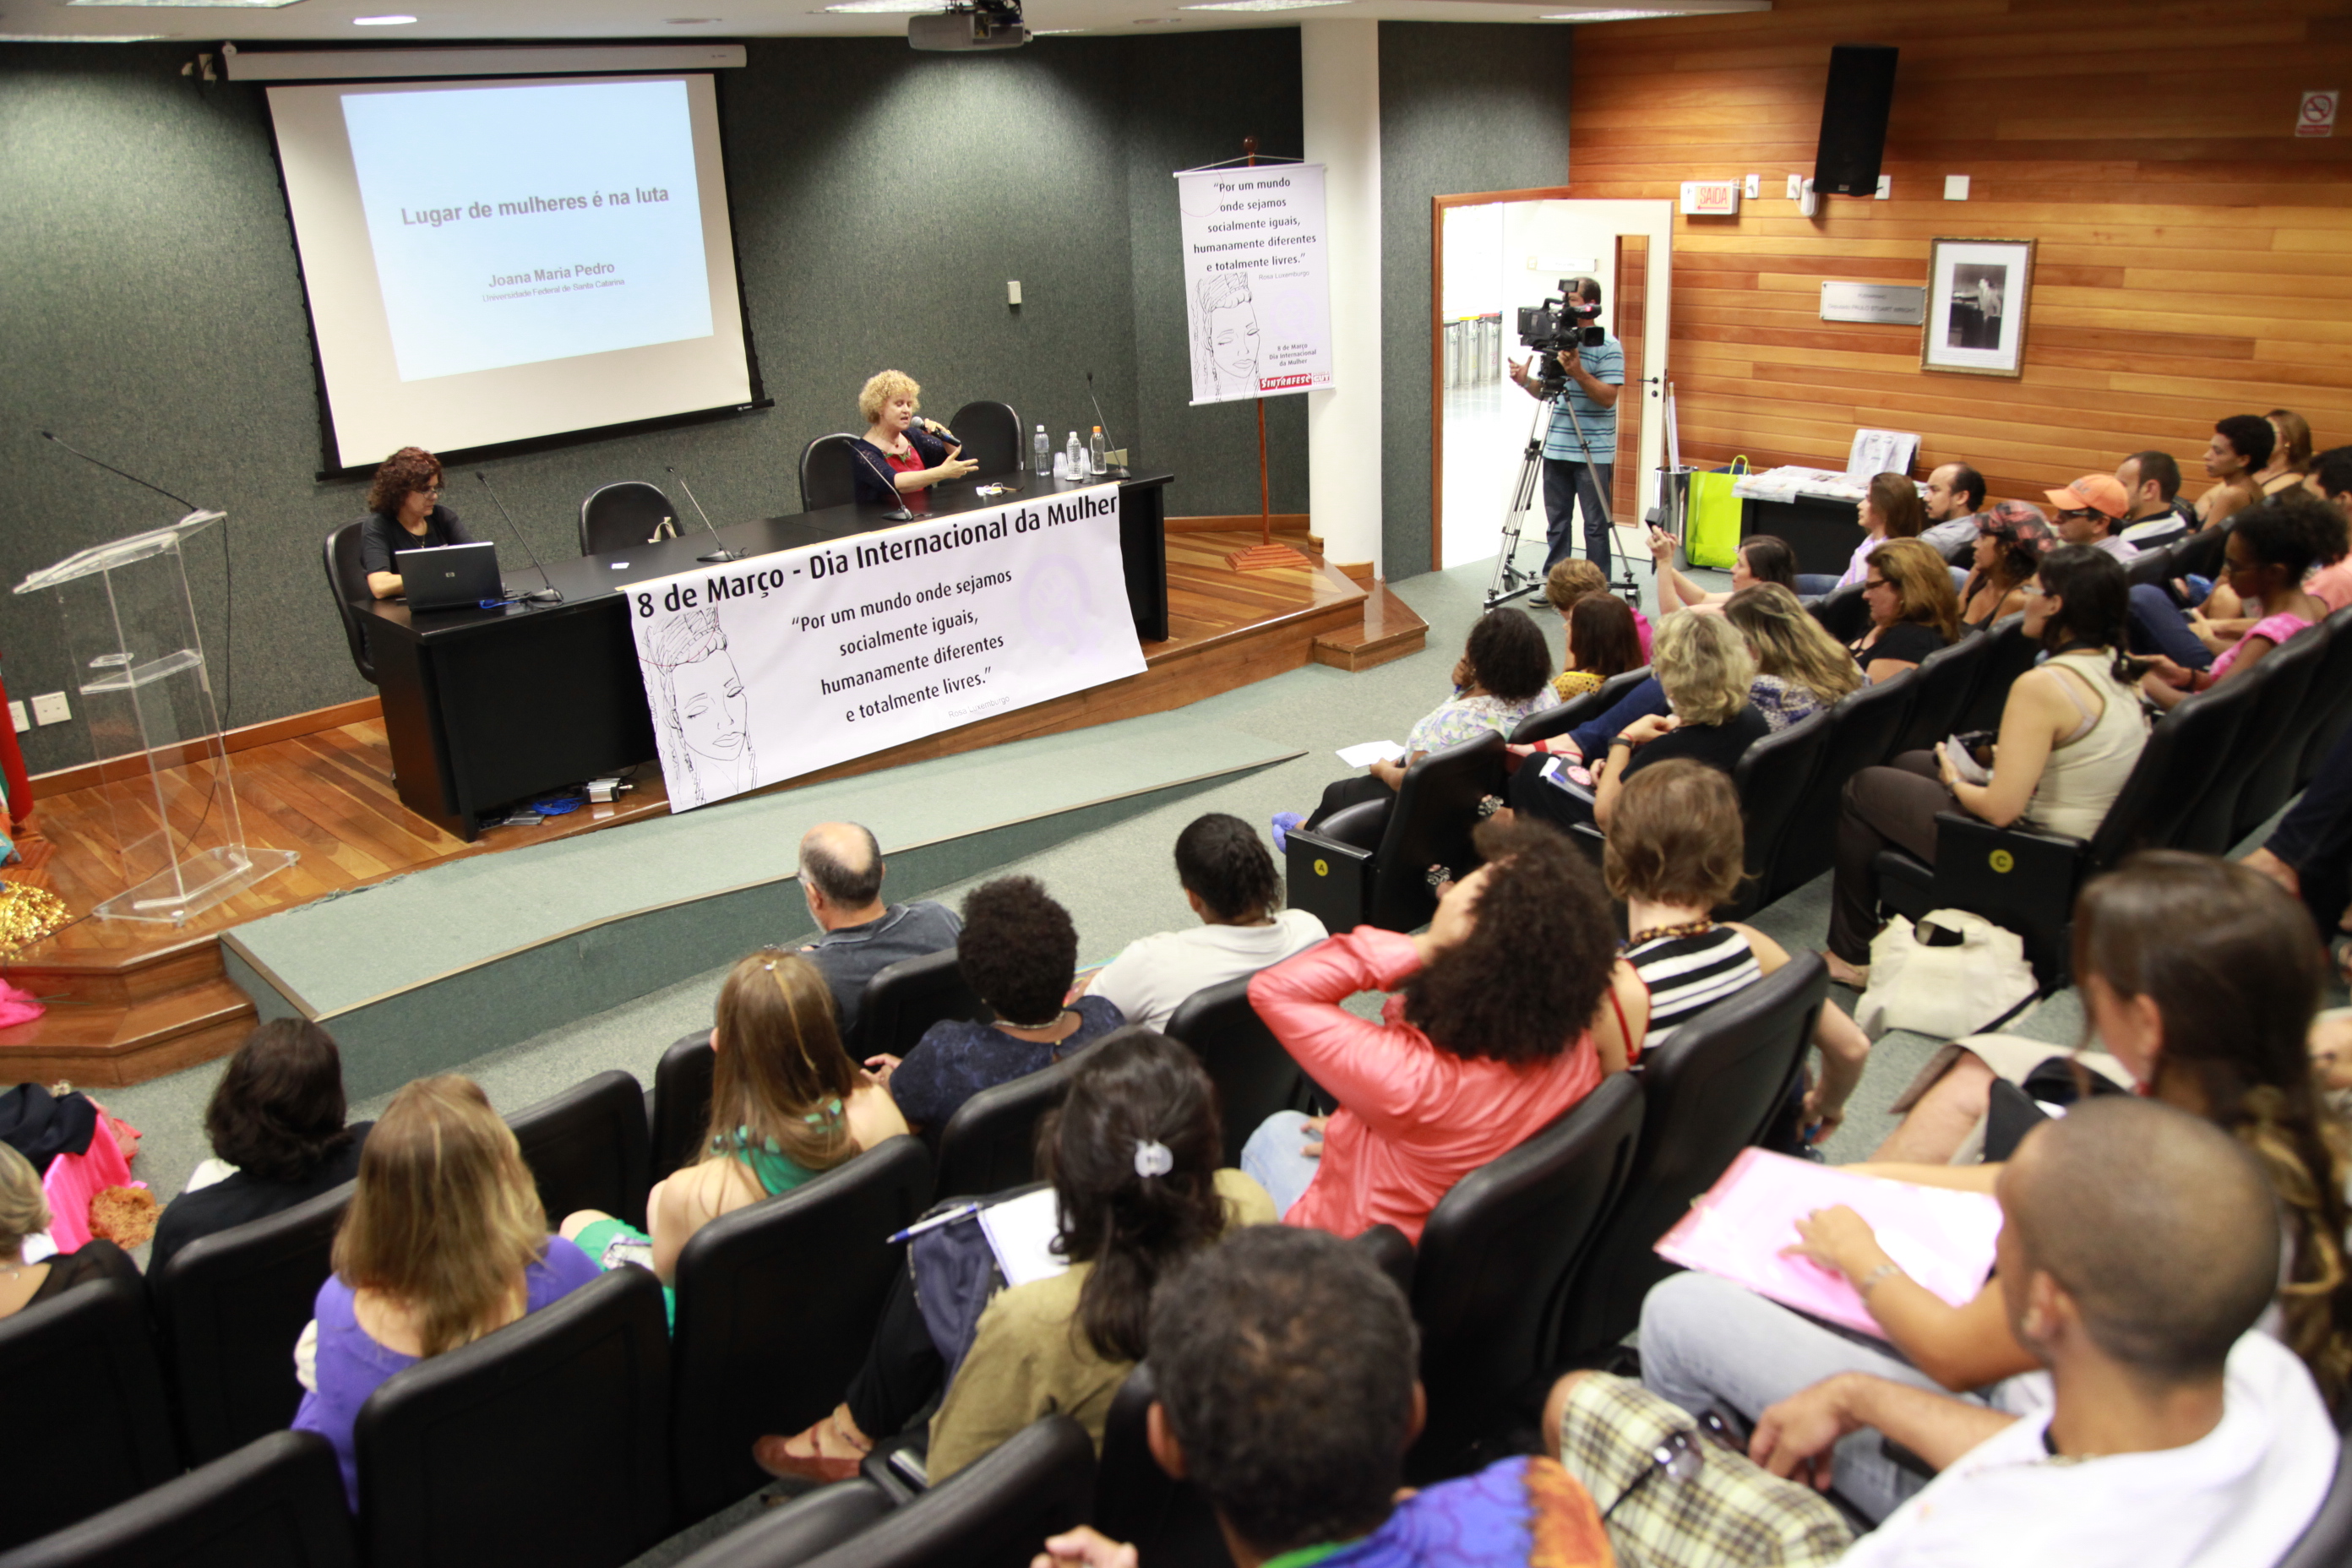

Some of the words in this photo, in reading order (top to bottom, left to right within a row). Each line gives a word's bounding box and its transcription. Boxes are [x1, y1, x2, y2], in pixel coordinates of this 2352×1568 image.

[1239, 182, 1254, 191] um
[1257, 177, 1290, 189] mundo
[401, 207, 462, 227] Lugar
[468, 201, 493, 219] de
[498, 196, 588, 216] mulheres
[592, 190, 603, 208] é
[609, 192, 630, 206] na
[635, 188, 669, 204] luta
[1220, 201, 1244, 212] onde
[1247, 199, 1287, 211] sejamos
[1207, 220, 1266, 233] socialmente
[1269, 215, 1301, 229] iguais,
[1194, 239, 1266, 254] humanamente
[1267, 235, 1316, 248] diferentes
[1216, 258, 1269, 271] totalmente
[1275, 270, 1309, 280] Luxemburgo
[488, 274, 531, 288] Joana
[534, 267, 571, 281] Maria
[574, 263, 615, 277] Pedro
[482, 290, 531, 302] Universidade
[533, 286, 560, 297] Federal
[573, 282, 593, 291] Santa
[596, 278, 625, 288] Catarina
[1280, 349, 1317, 359] Internacional
[638, 592, 654, 618] 8
[664, 583, 698, 612] de
[708, 569, 784, 603] Março
[809, 550, 849, 580] Dia
[856, 513, 1008, 569] Internacional
[1015, 509, 1041, 534] da
[1048, 494, 1118, 527] Mulher
[830, 607, 856, 624] um
[860, 592, 912, 618] mundo
[916, 582, 951, 603] onde
[956, 570, 1012, 595] sejamos
[840, 623, 928, 656] socialmente
[932, 609, 978, 634] iguais,
[820, 655, 929, 695] humanamente
[934, 635, 1004, 665] diferentes
[846, 710, 855, 722] e
[858, 685, 939, 718] totalmente
[948, 708, 967, 719] Rosa
[968, 696, 1010, 713] Luxemburgo
[1318, 863, 1326, 873] A
[1996, 855, 2007, 868] C
